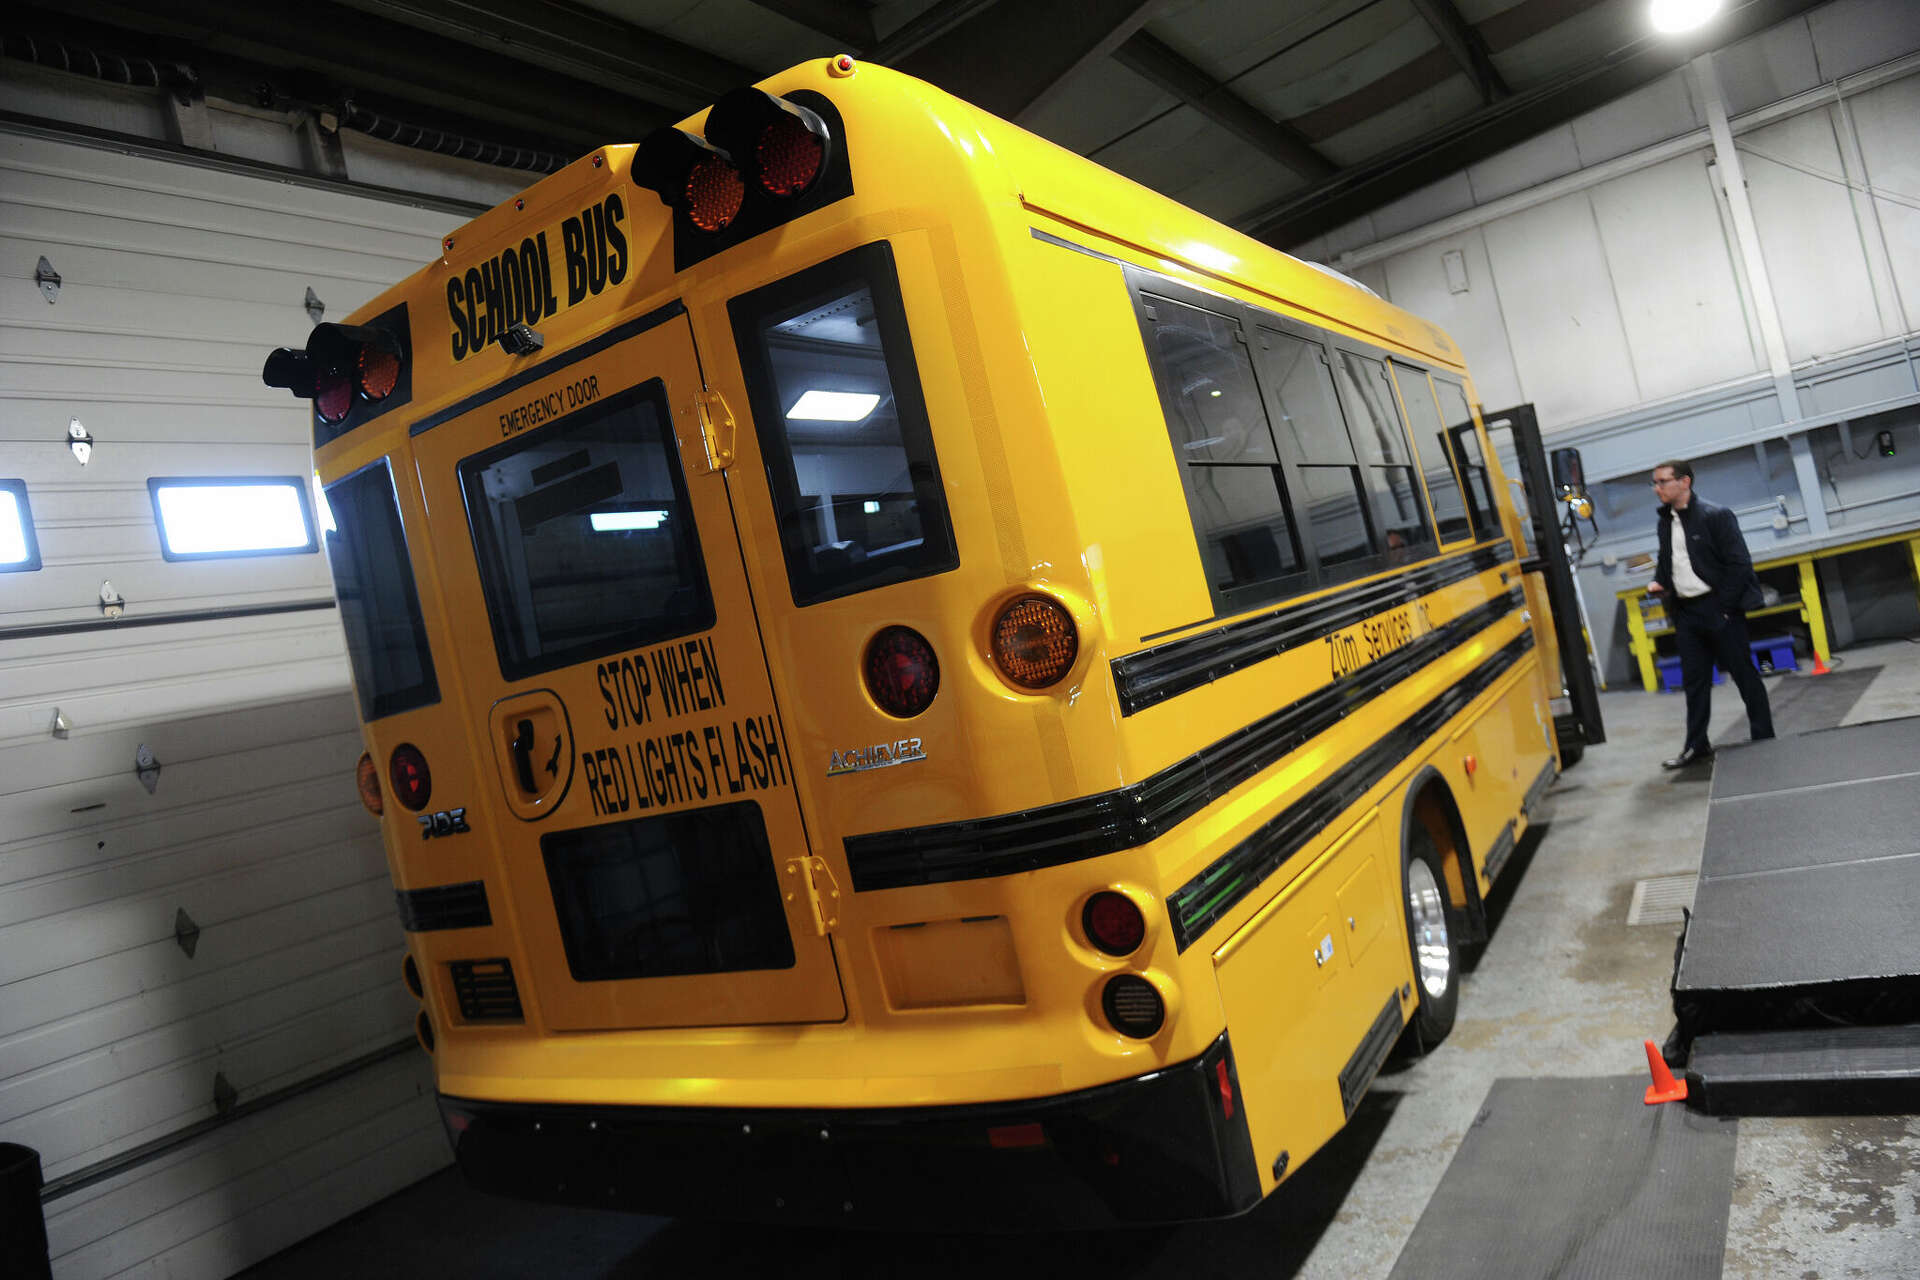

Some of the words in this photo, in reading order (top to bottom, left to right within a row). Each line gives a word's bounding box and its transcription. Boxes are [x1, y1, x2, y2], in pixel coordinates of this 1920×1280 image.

[446, 231, 557, 361] SCHOOL
[562, 193, 628, 307] BUS
[500, 389, 565, 437] EMERGENCY
[567, 375, 600, 407] DOOR
[597, 655, 652, 731] STOP
[650, 636, 726, 718] WHEN
[582, 747, 630, 816] RED
[626, 730, 708, 809] LIGHTS
[703, 714, 787, 796] FLASH
[827, 737, 925, 773] ACHIEVER
